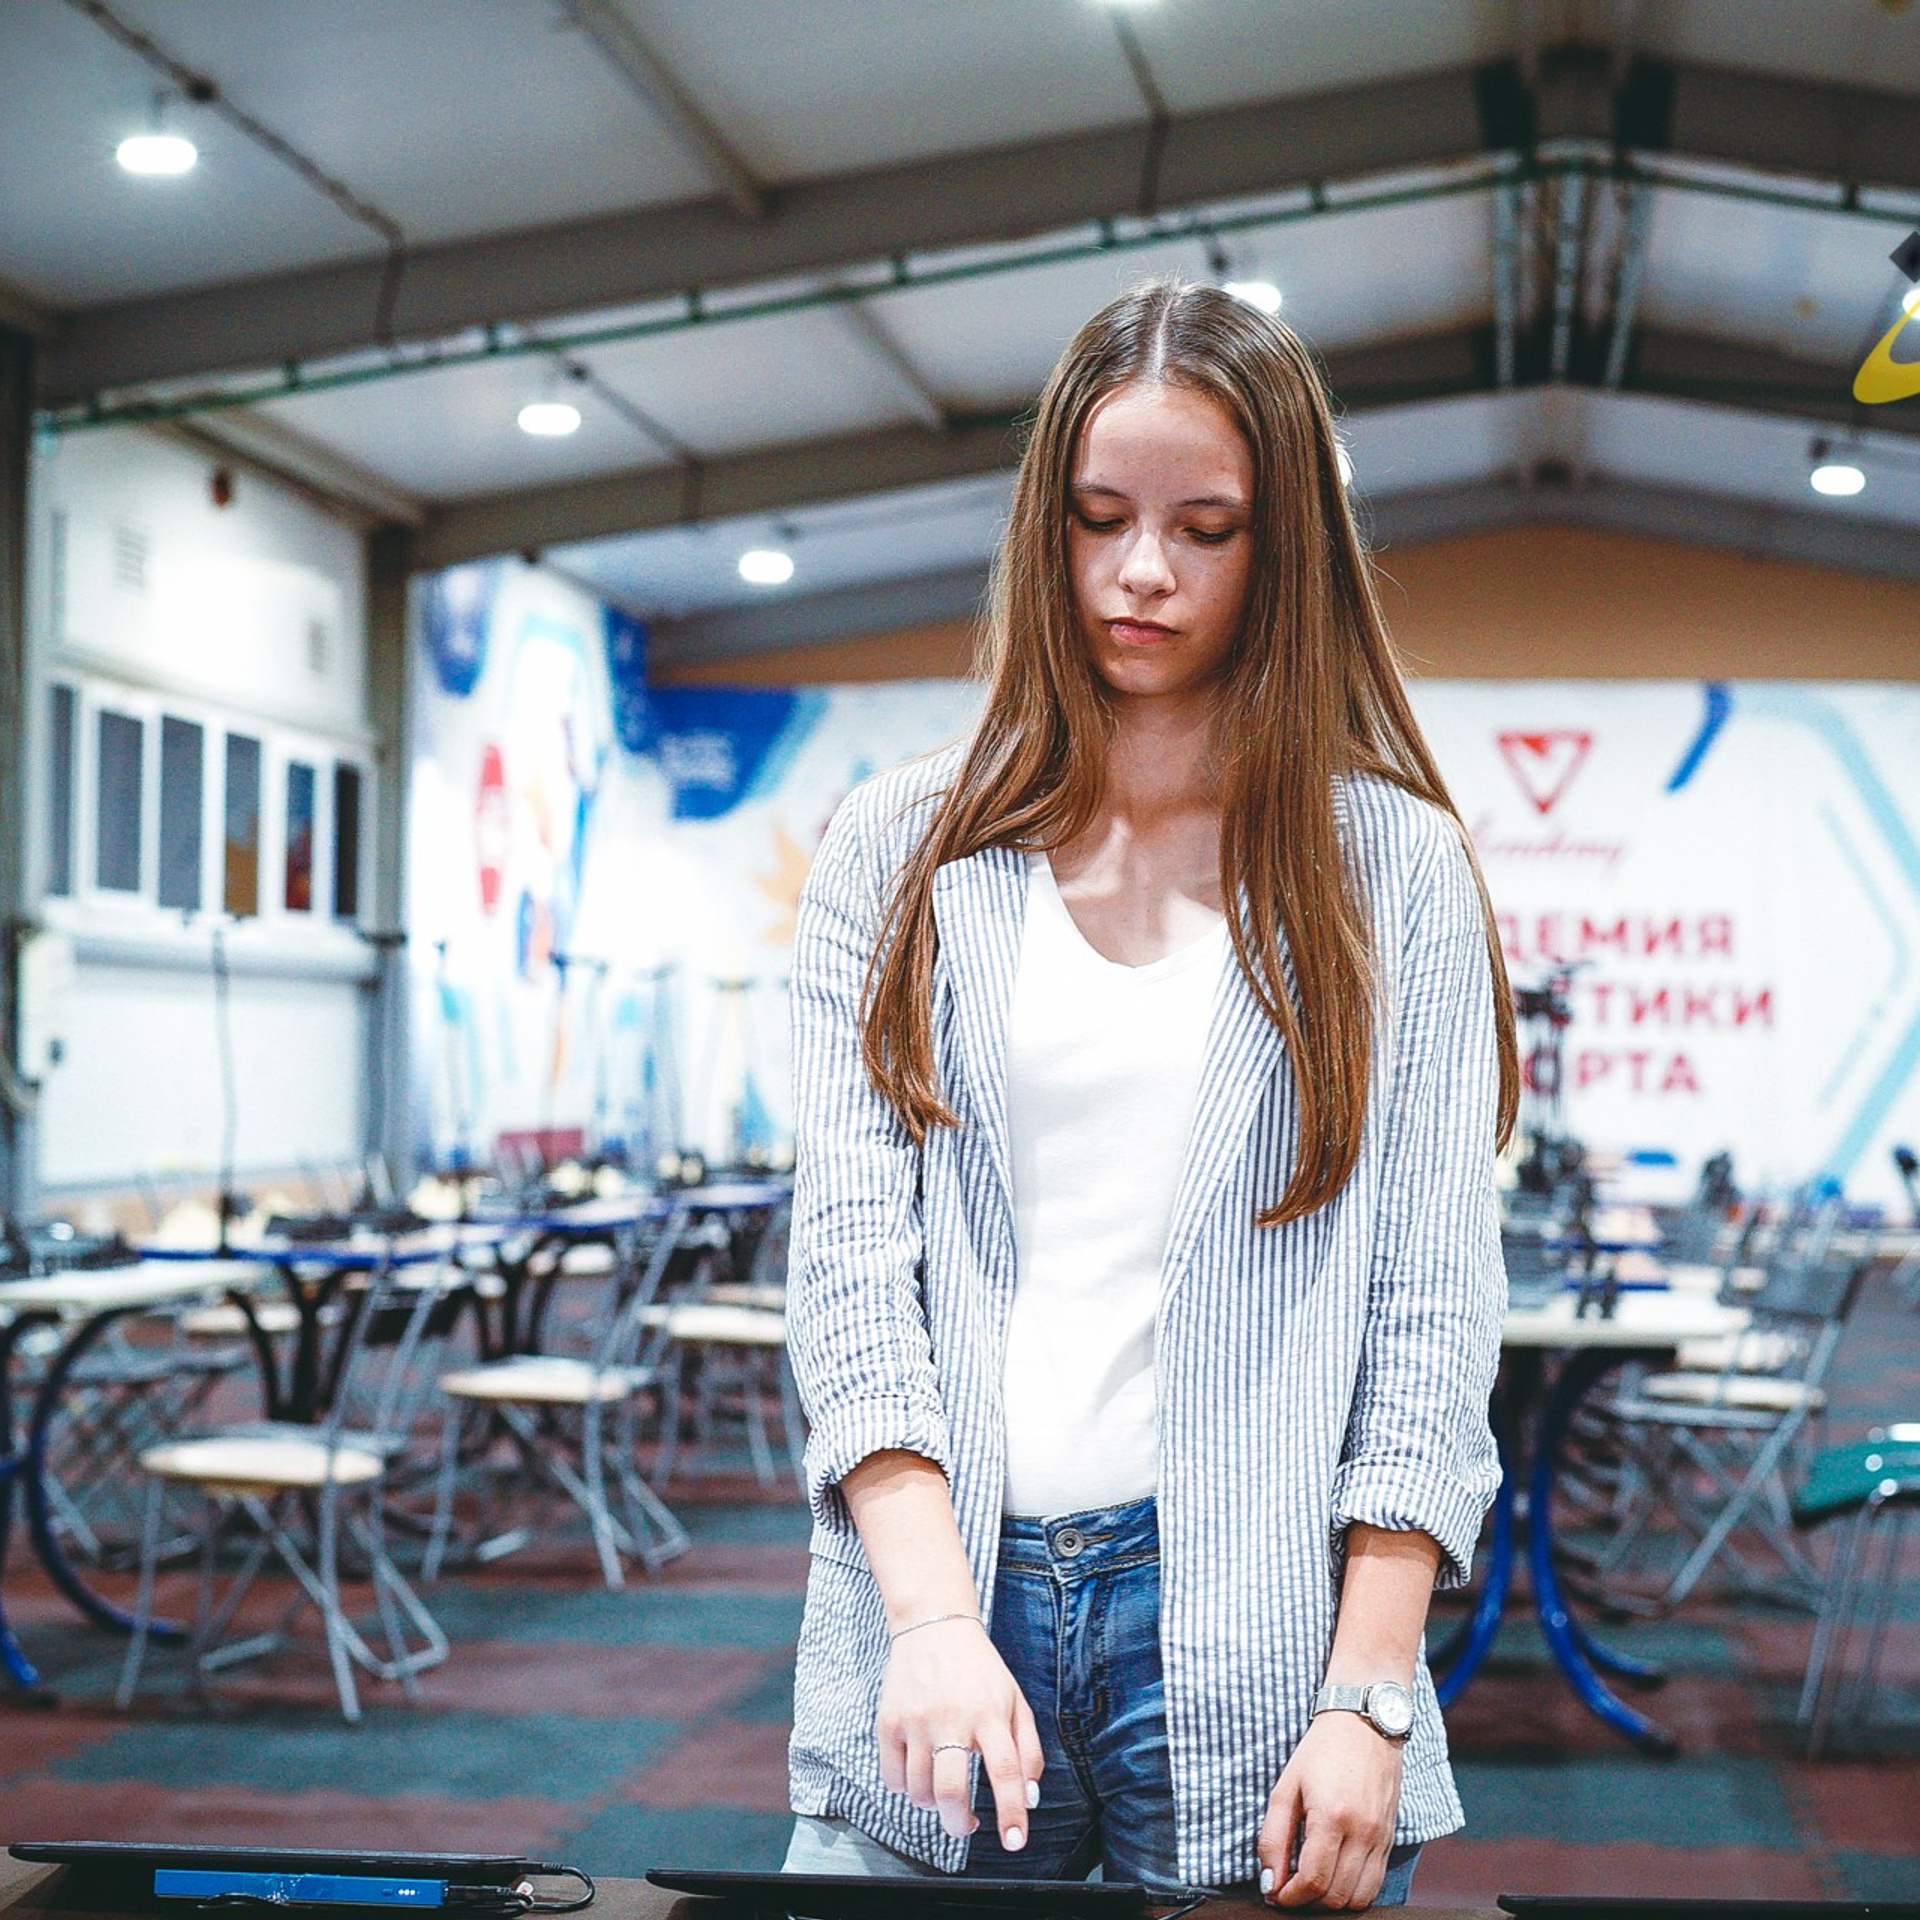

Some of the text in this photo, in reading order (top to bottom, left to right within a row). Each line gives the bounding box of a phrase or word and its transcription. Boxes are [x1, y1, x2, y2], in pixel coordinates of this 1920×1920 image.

[1497, 912, 1733, 962] ДЕМИЯ
[1548, 977, 1775, 1028] ТИКИ
[1519, 1045, 1703, 1096] ОРТА
